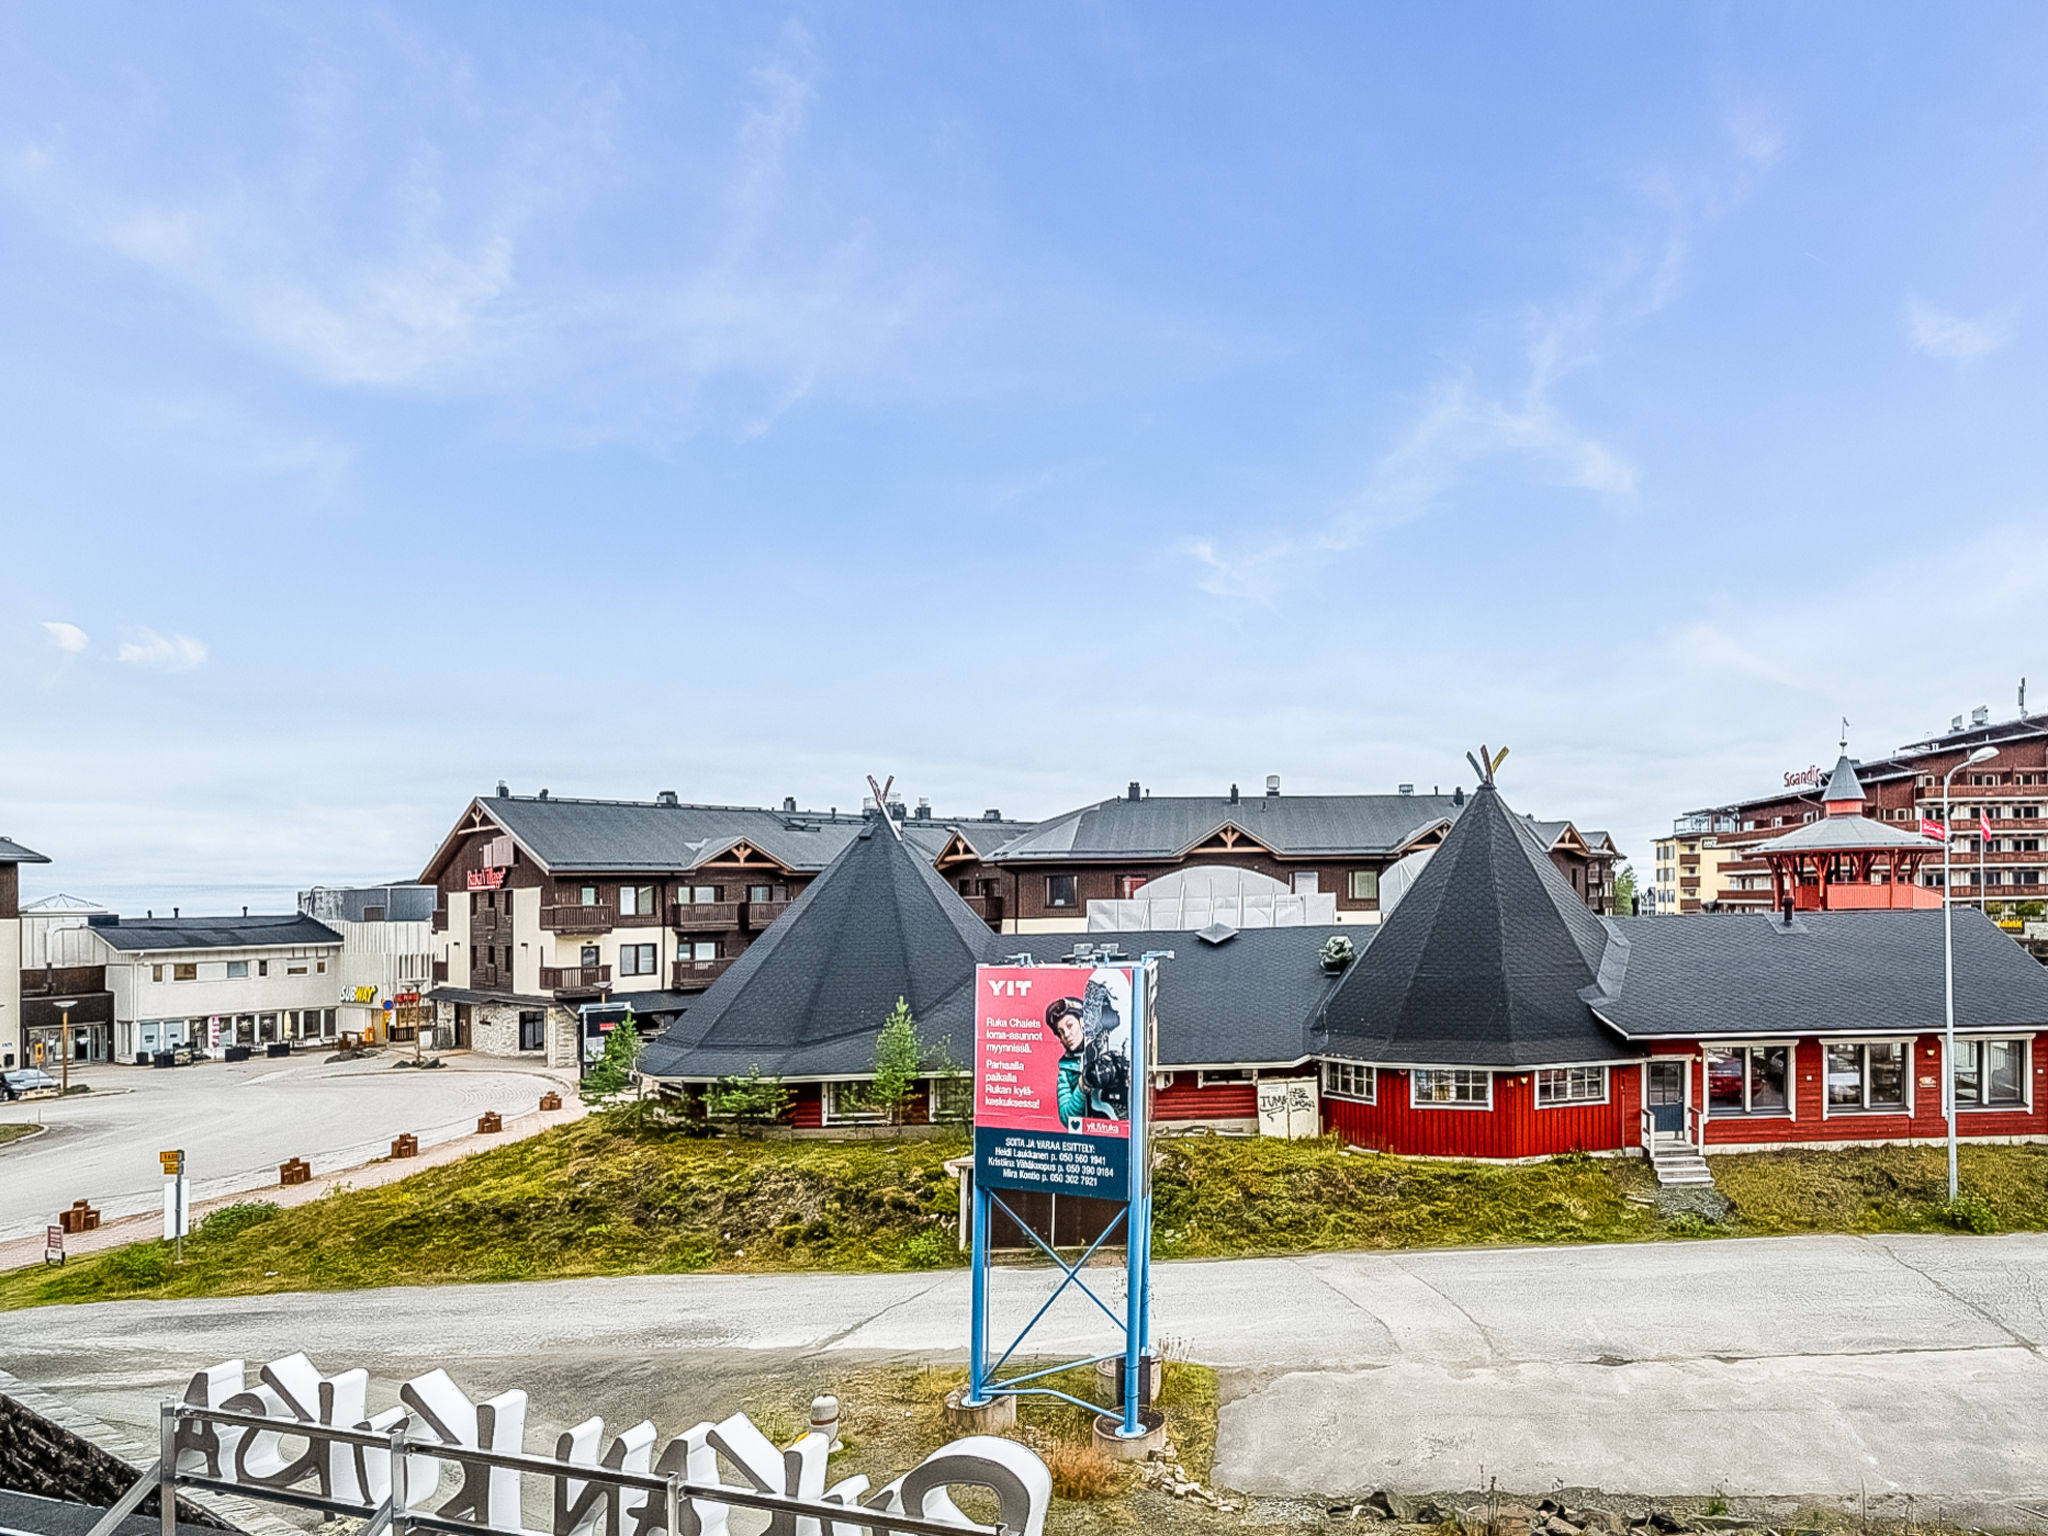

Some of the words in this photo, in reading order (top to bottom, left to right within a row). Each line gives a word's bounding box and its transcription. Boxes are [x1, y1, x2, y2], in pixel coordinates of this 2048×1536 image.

[1784, 765, 1822, 788] Scandic
[340, 985, 378, 1003] SUBWAY
[988, 980, 1033, 996] YIT
[986, 1017, 1007, 1028] Ruka
[1009, 1018, 1041, 1028] Chalets
[986, 1030, 1043, 1040] loma-asunnot
[986, 1043, 1032, 1054] myynnissä.
[986, 1060, 1024, 1070] Parhaalla
[985, 1072, 1018, 1083] paikalla
[985, 1084, 1012, 1094] Rukan
[1013, 1085, 1034, 1097] kylä-
[984, 1096, 1040, 1109] keskuksessa!
[1005, 1137, 1025, 1148] SOITA
[1026, 1139, 1035, 1148] JA
[1036, 1140, 1060, 1151] VARAA
[1062, 1141, 1095, 1154] ESITTELY:
[995, 1147, 1012, 1157] Heidi
[1013, 1149, 1048, 1160] Laukkanen
[1050, 1153, 1057, 1162] p.
[1059, 1153, 1073, 1163] 050
[1057, 1164, 1064, 1174] p.
[1066, 1163, 1080, 1174] 050
[1002, 1168, 1018, 1179] Mira
[1041, 1174, 1048, 1183] p.
[1050, 1173, 1064, 1183] 050
[1065, 1174, 1079, 1184] 302
